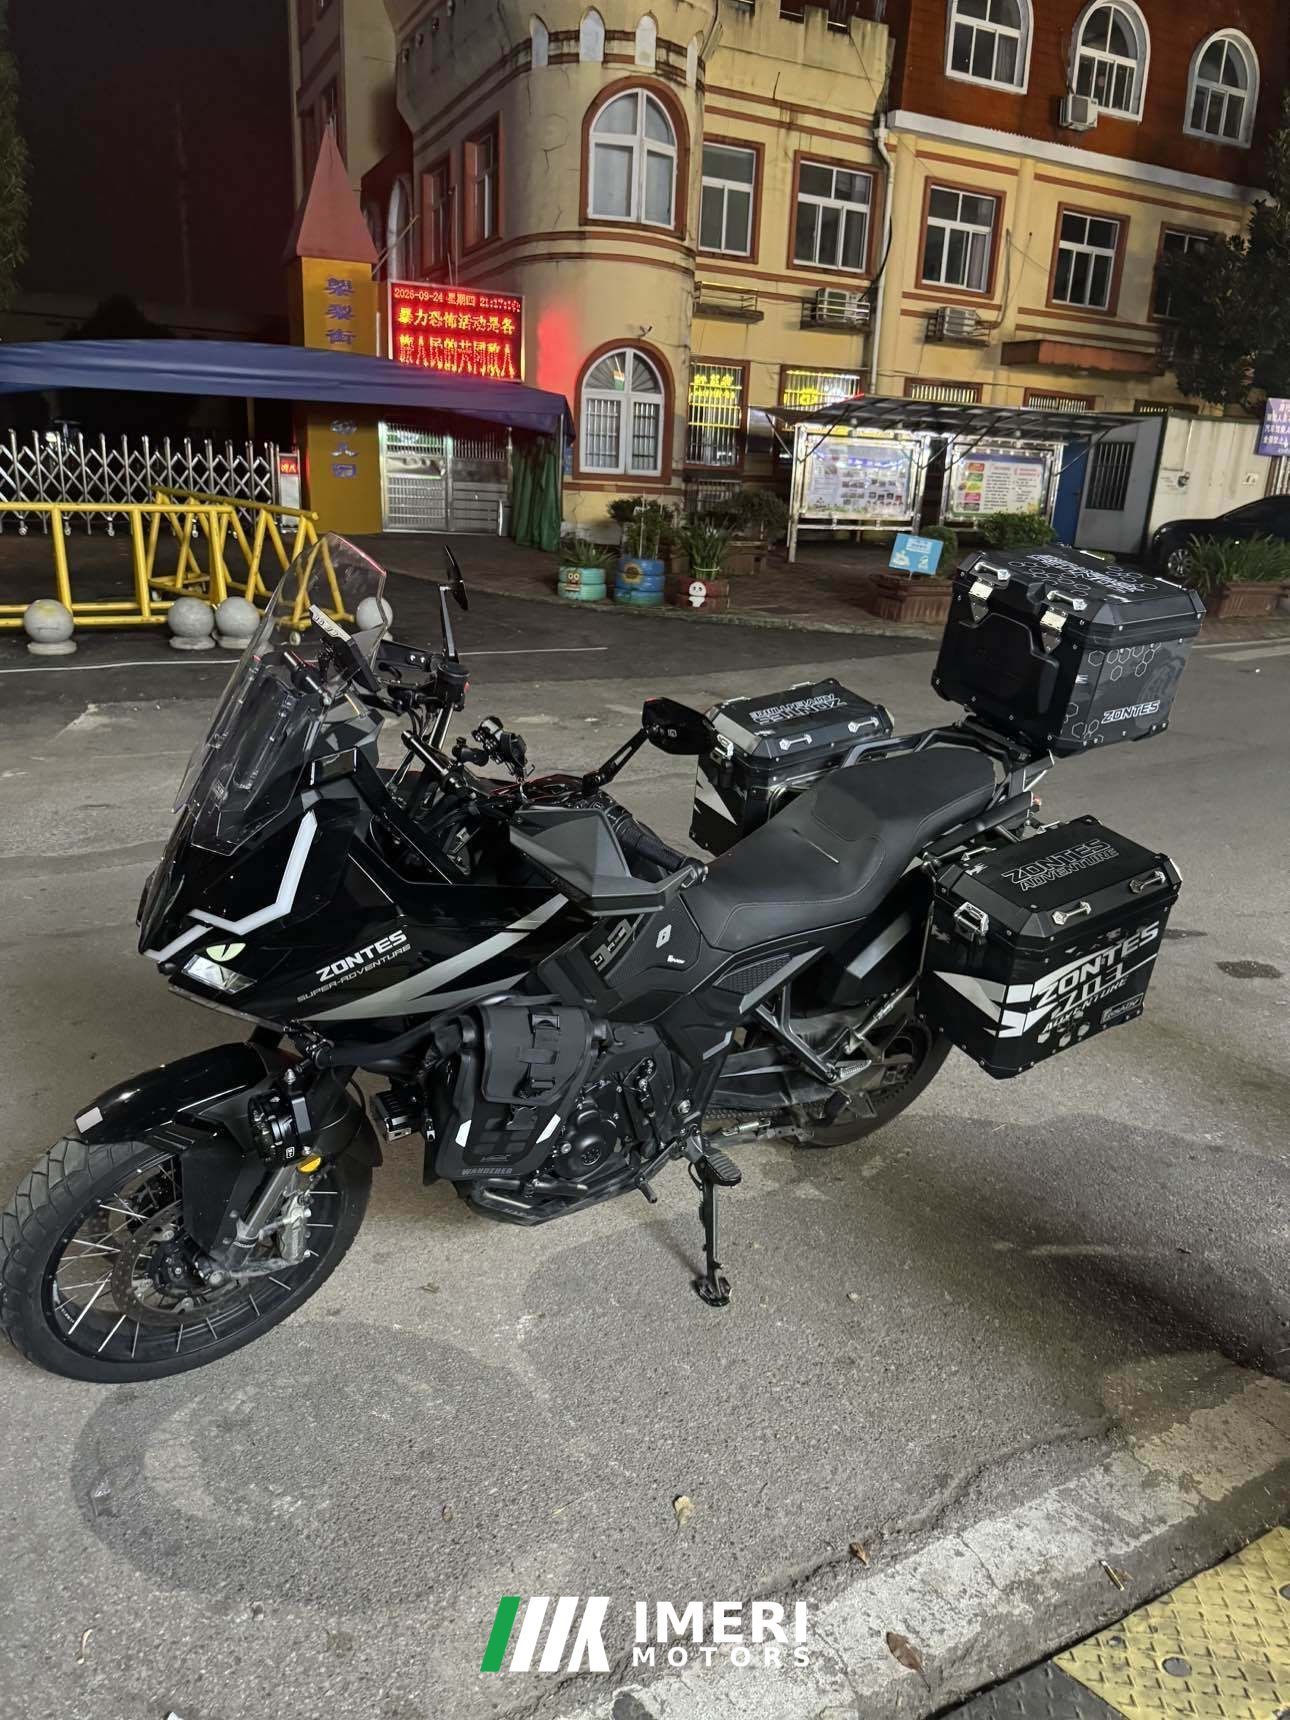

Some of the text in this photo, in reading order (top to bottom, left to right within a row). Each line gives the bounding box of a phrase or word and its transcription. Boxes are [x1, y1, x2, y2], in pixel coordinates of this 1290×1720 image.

[394, 288, 443, 302] 2026-09-24
[447, 292, 476, 307] 星期四
[399, 307, 515, 335] 暴力恐怖活动是各
[1101, 700, 1160, 724] ZONTES
[1001, 839, 1111, 883] ZONTES
[1020, 846, 1120, 891] ADVENTURE
[297, 943, 411, 1002] SUPER-ADVENTURE
[316, 930, 407, 982] ZONTES
[1036, 921, 1159, 1008] ZONTES
